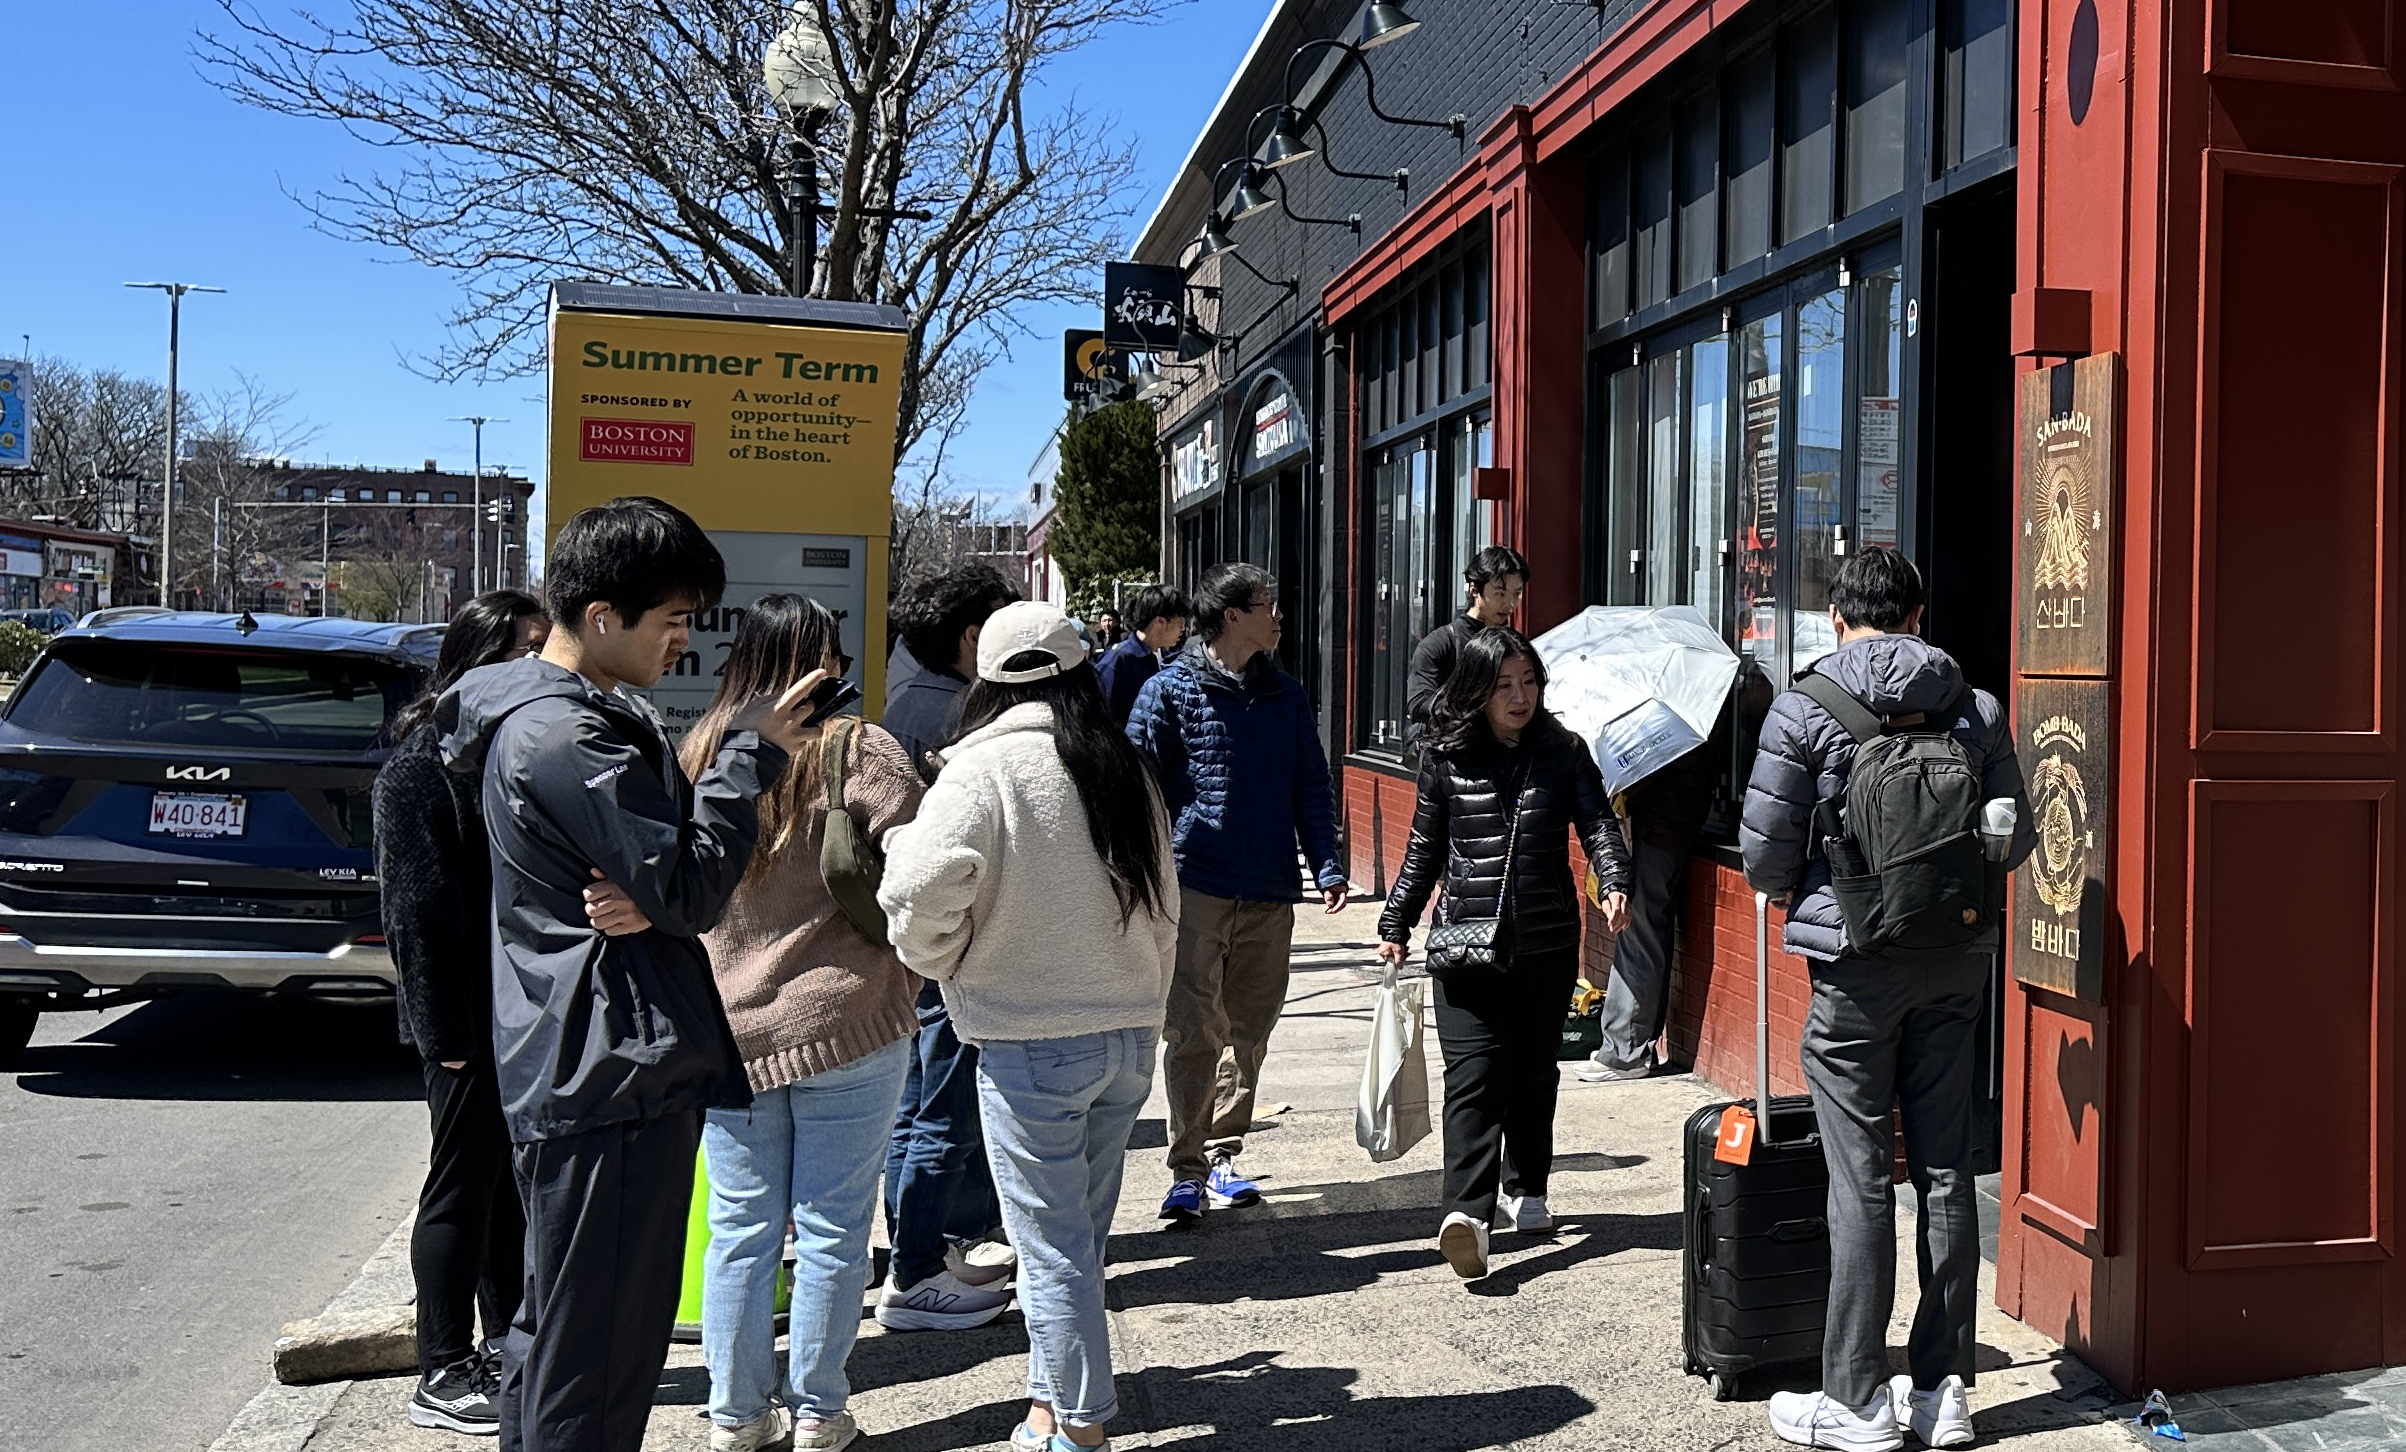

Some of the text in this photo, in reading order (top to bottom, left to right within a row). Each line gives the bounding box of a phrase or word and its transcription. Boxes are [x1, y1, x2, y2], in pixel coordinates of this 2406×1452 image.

[581, 341, 879, 384] Summer Term
[580, 394, 693, 409] SPONSORED BY
[731, 389, 841, 407] A world of
[589, 425, 685, 443] BOSTON
[730, 425, 852, 444] in the heart
[589, 443, 685, 458] UNIVERSITY
[728, 445, 832, 463] of Boston.
[666, 706, 707, 720] Regist
[166, 765, 231, 781] KIA
[1725, 1121, 1747, 1149] J
